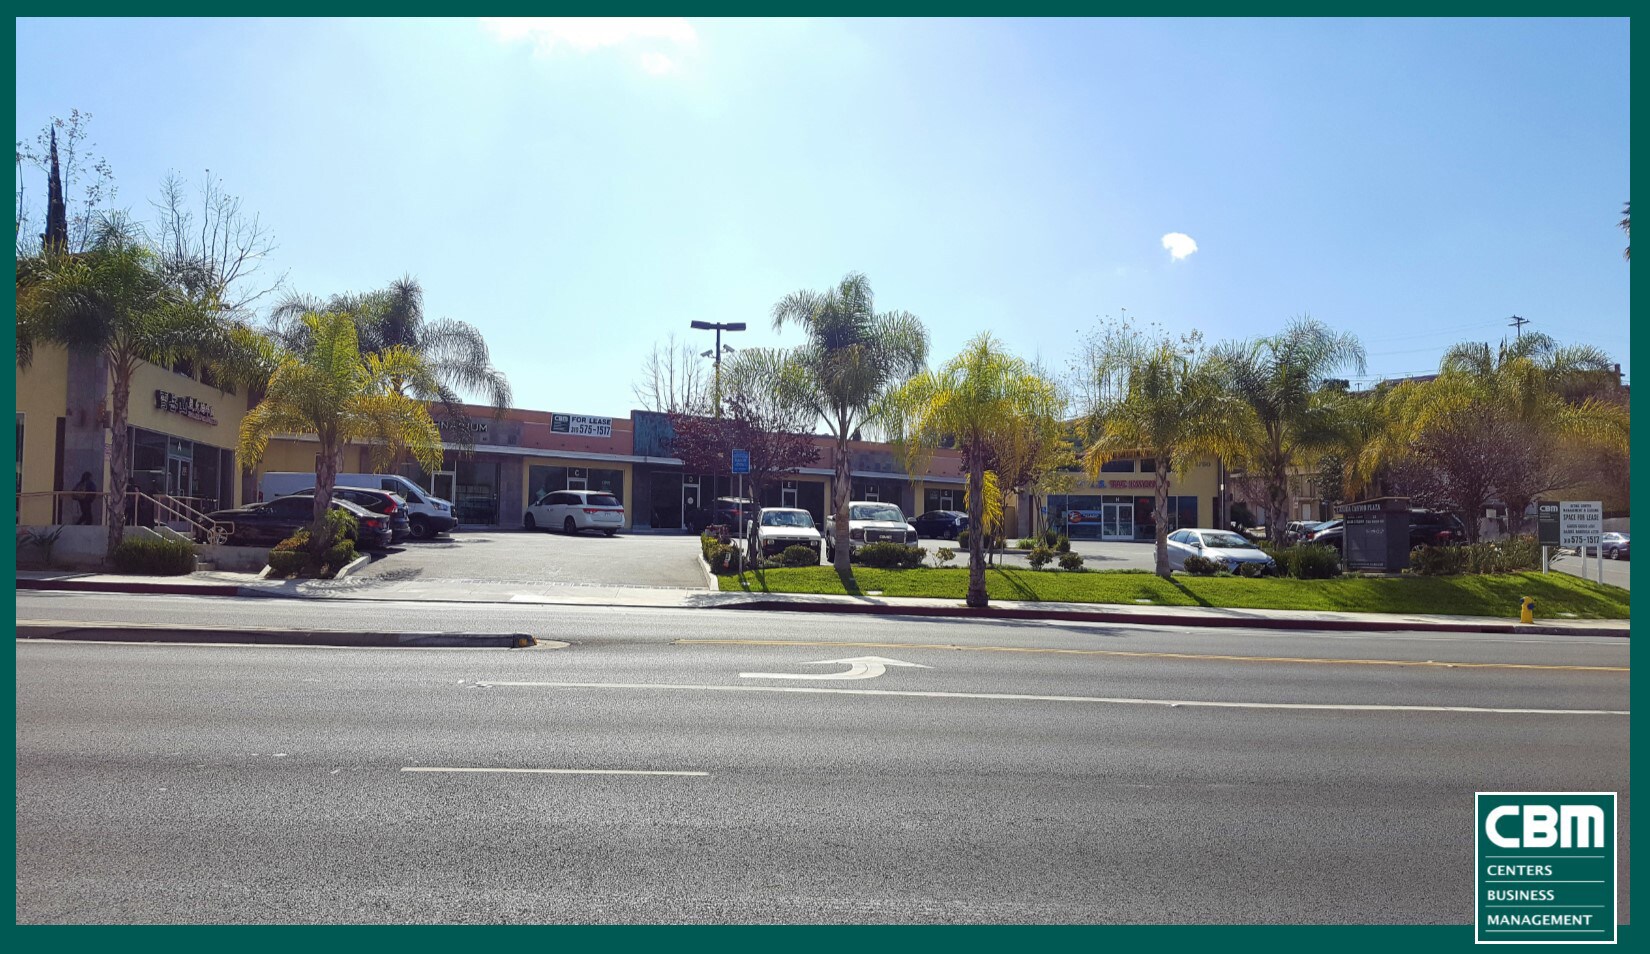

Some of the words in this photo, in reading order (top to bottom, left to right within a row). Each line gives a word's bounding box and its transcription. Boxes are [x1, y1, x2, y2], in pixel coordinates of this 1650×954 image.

[571, 416, 587, 424] FOR
[589, 417, 611, 426] LEASE
[579, 424, 611, 436] 575-1517
[574, 469, 580, 477] C
[1367, 503, 1381, 511] PLAZA
[1563, 513, 1576, 521] SPACE
[1577, 513, 1585, 521] FOR
[1586, 513, 1599, 521] LEASE
[1571, 535, 1600, 544] 575-1517
